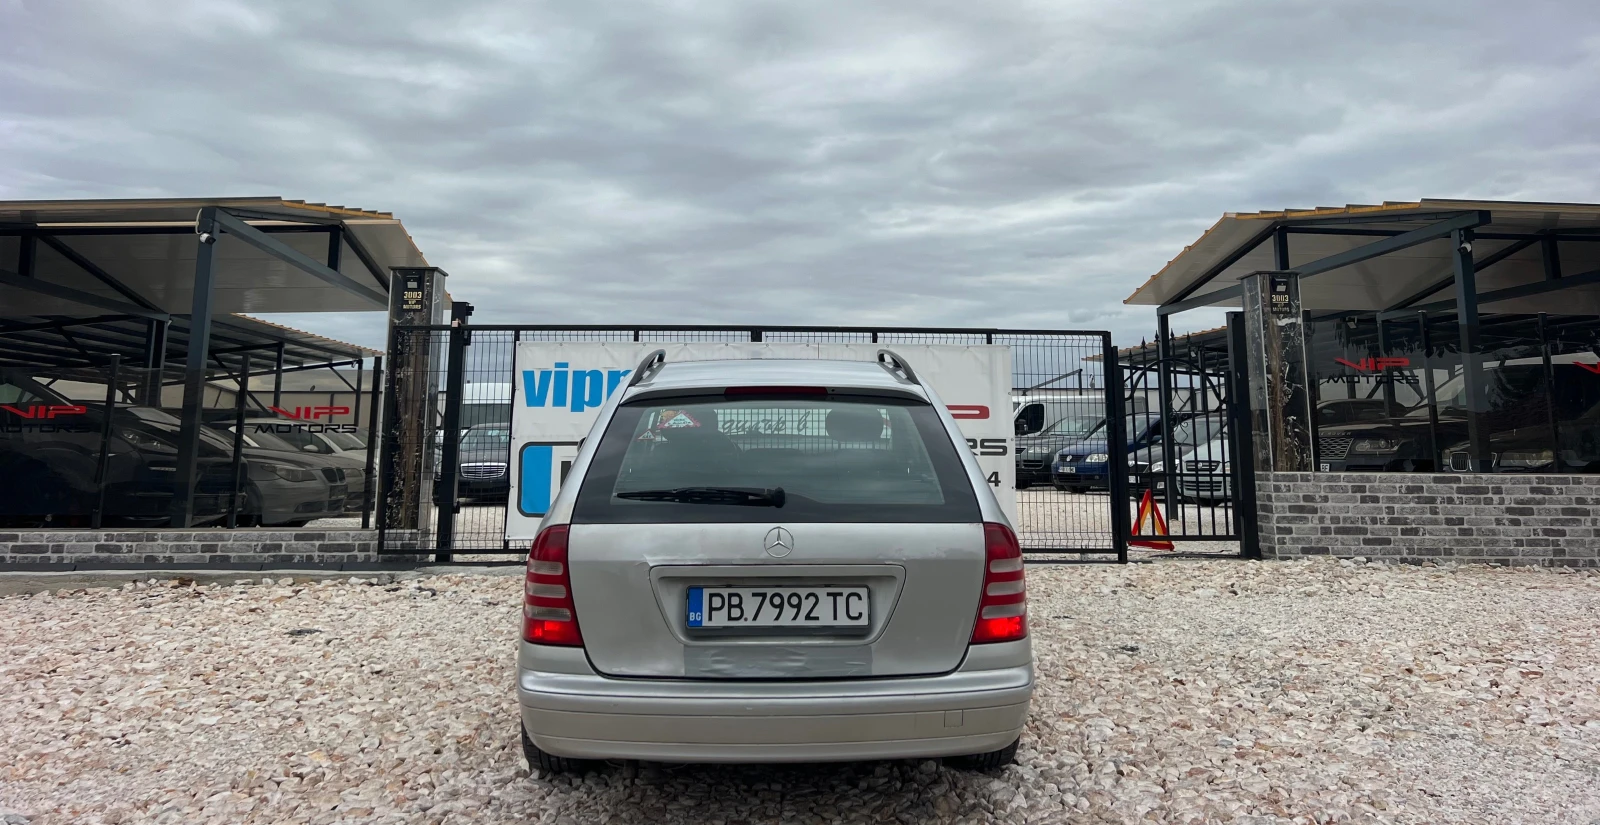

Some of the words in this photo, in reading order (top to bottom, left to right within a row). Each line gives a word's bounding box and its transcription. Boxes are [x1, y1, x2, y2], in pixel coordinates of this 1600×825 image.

[1334, 357, 1409, 370] VIP
[0, 405, 87, 418] VIP
[267, 406, 349, 419] VIP
[254, 424, 358, 433] MOTORS
[827, 592, 863, 620] TC
[689, 612, 701, 621] BG
